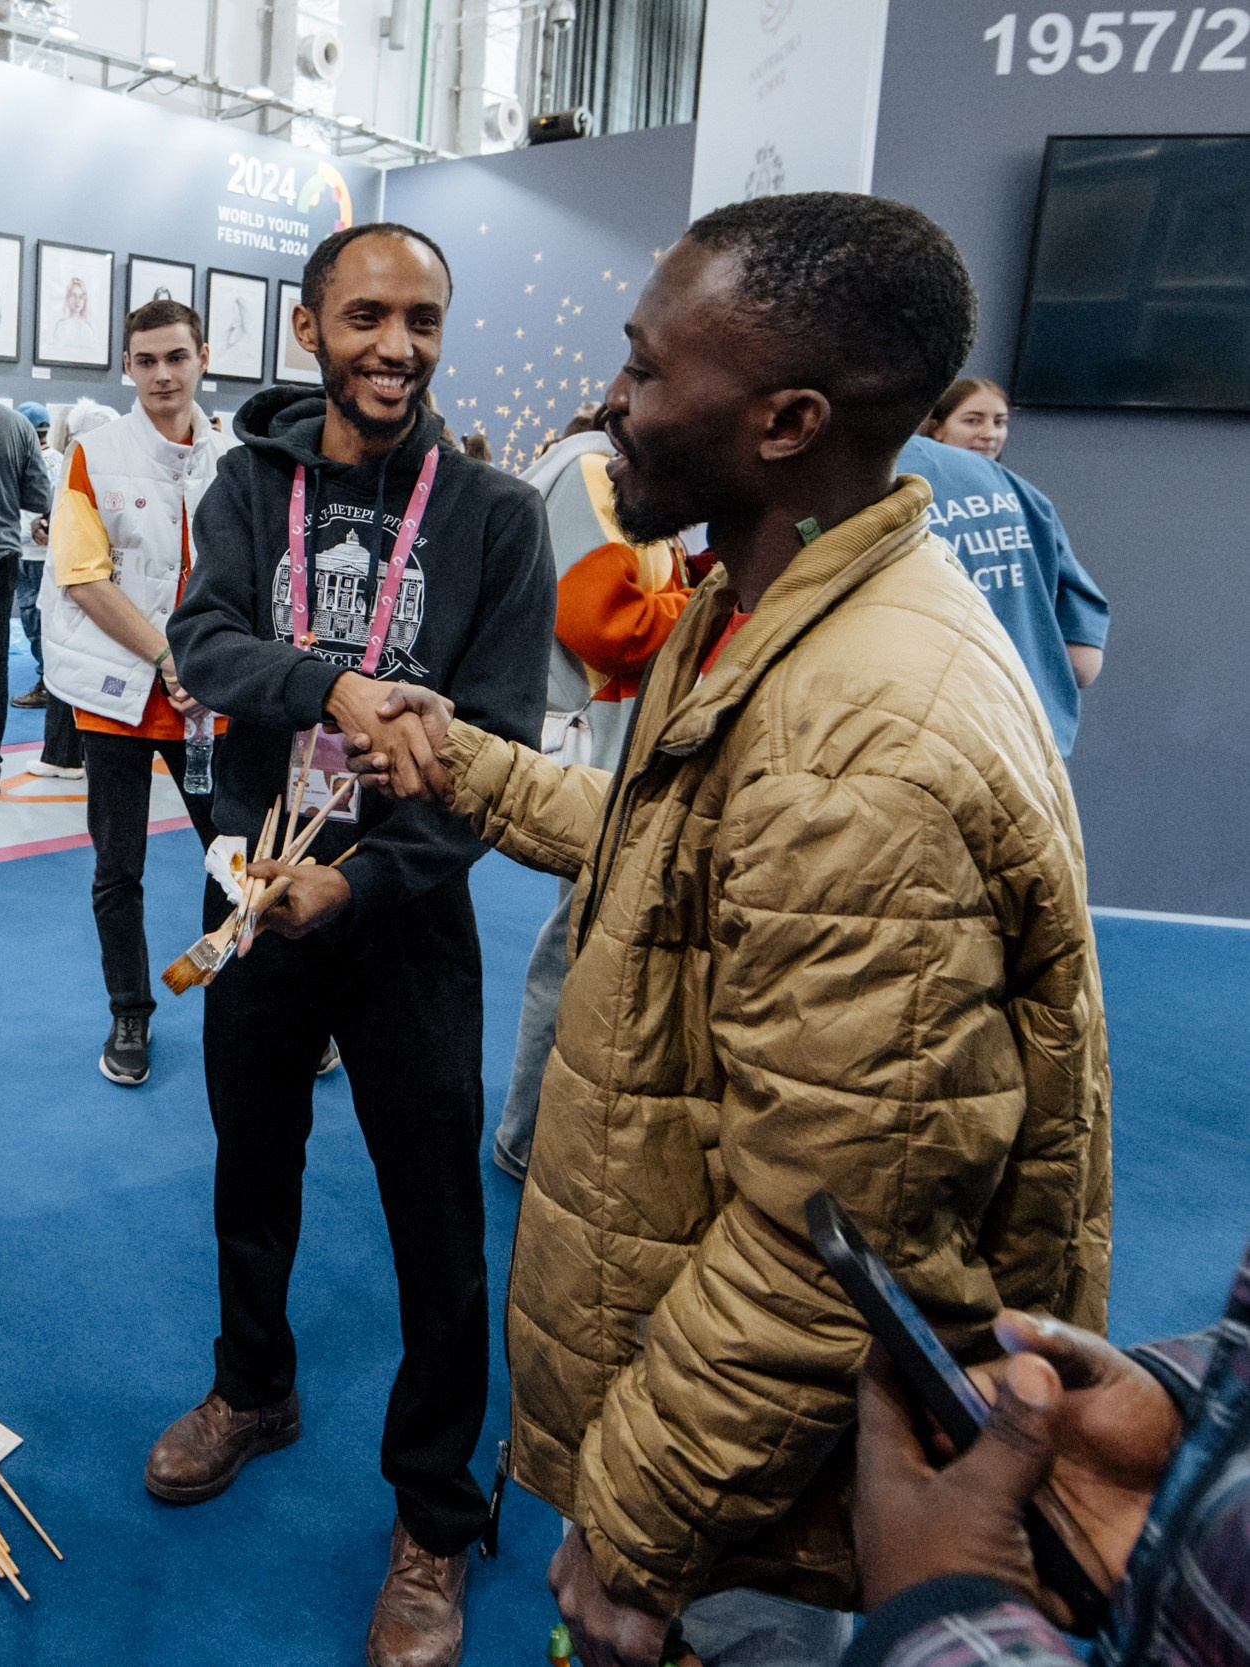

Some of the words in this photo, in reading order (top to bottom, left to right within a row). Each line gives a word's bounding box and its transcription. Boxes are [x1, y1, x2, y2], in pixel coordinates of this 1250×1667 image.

[983, 8, 1249, 75] 1957/2
[226, 152, 297, 206] 2024
[217, 205, 265, 229] WORLD
[267, 215, 310, 238] YOUTH
[217, 226, 277, 251] FESTIVAL
[279, 238, 309, 257] 2024
